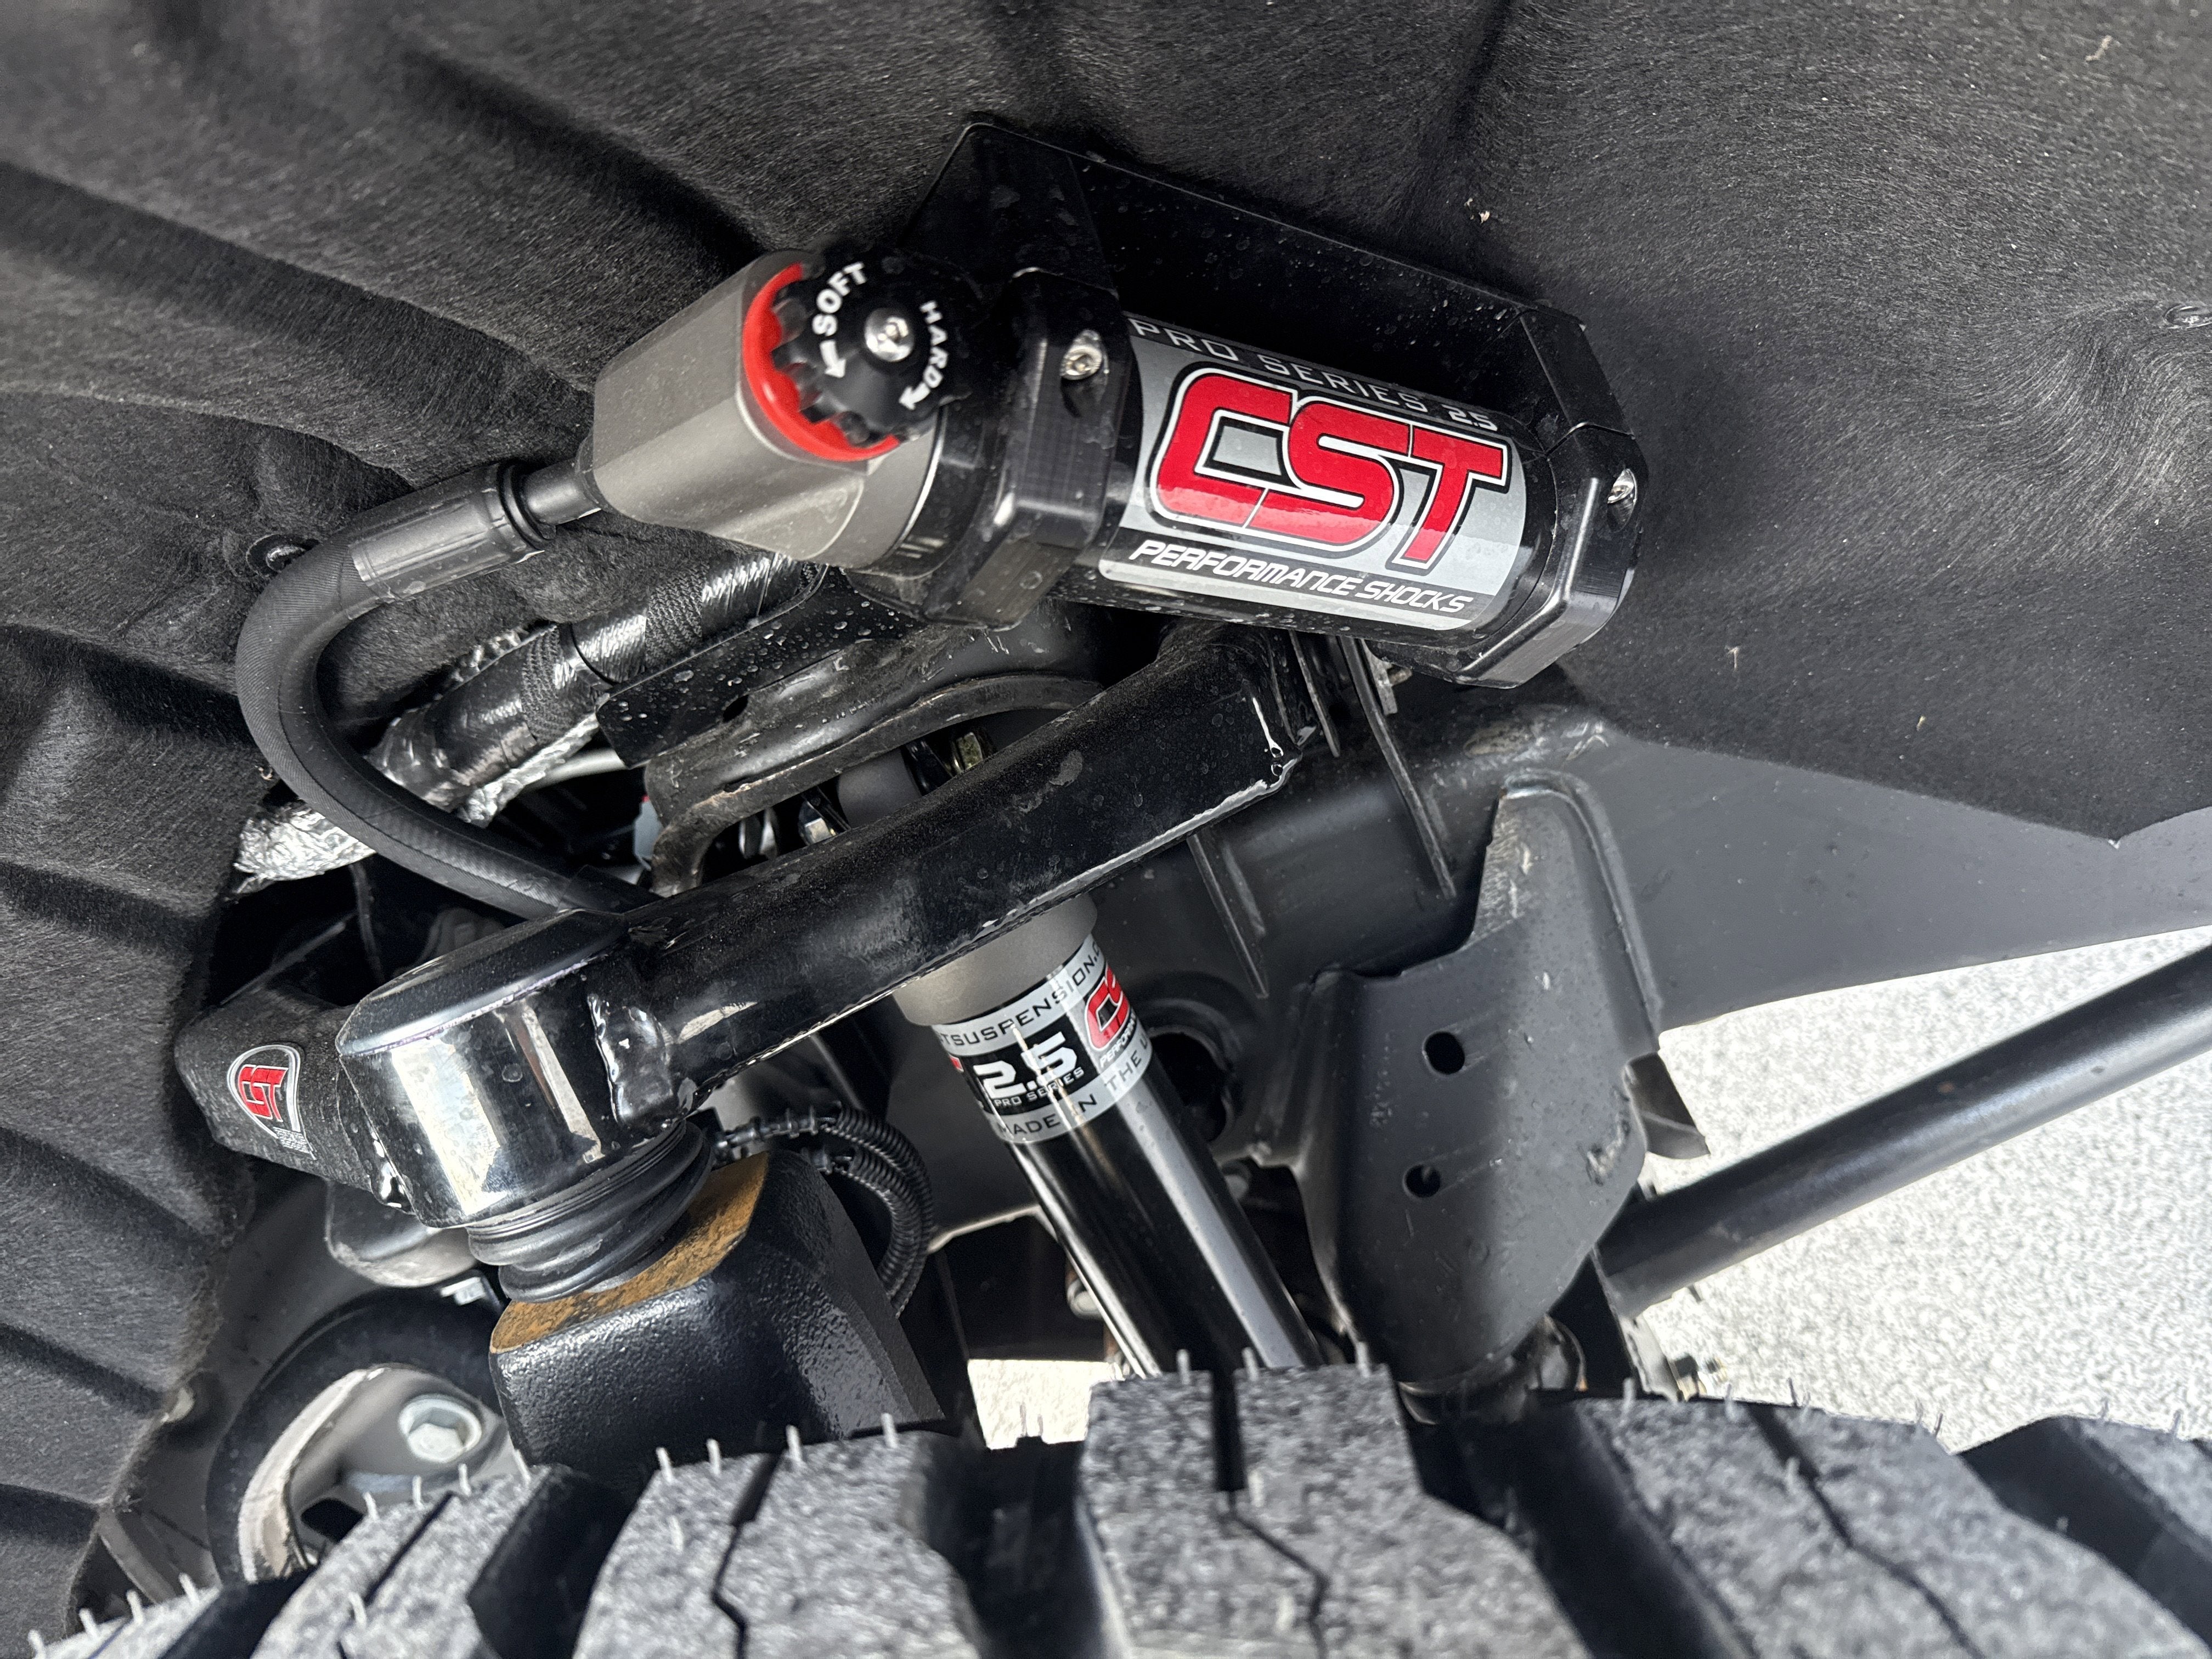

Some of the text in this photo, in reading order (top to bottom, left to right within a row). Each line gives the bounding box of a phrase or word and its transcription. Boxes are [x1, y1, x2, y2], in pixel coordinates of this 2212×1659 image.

[812, 262, 867, 336] SOFT
[919, 301, 949, 388] HARD
[1128, 318, 1498, 431] PRO SERIES 2.5
[1150, 368, 1509, 568] CST
[1128, 539, 1474, 613] PERFORMANCE SHOCKS
[238, 1064, 289, 1122] CST
[973, 1031, 1077, 1099] 2.5
[994, 1096, 1023, 1107] PRO
[1105, 1049, 1142, 1091] THE
